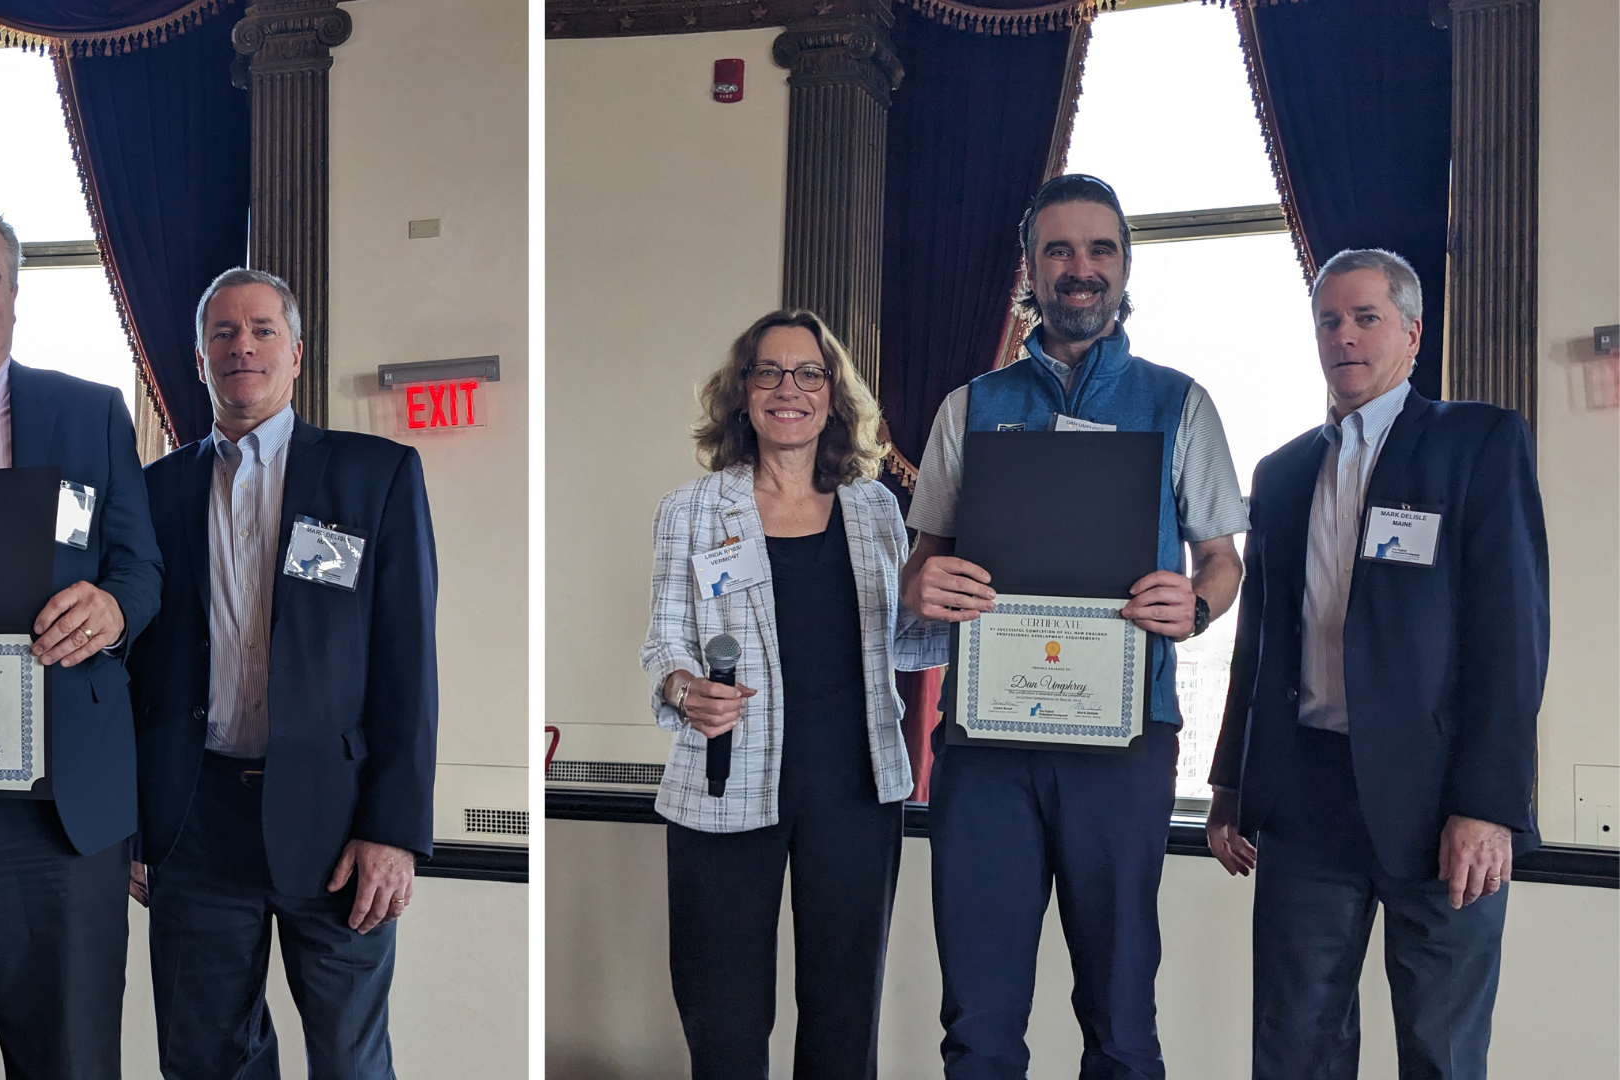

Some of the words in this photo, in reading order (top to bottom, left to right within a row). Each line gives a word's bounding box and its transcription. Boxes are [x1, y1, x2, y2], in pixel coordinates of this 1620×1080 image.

[406, 381, 478, 429] EXIT
[1400, 512, 1427, 521] DELISLE
[704, 551, 723, 560] LINDA
[710, 553, 740, 566] VERMONT
[1020, 618, 1083, 629] CERTIFICATE
[1010, 674, 1038, 688] Dan
[1040, 674, 1088, 696] Umphrey
